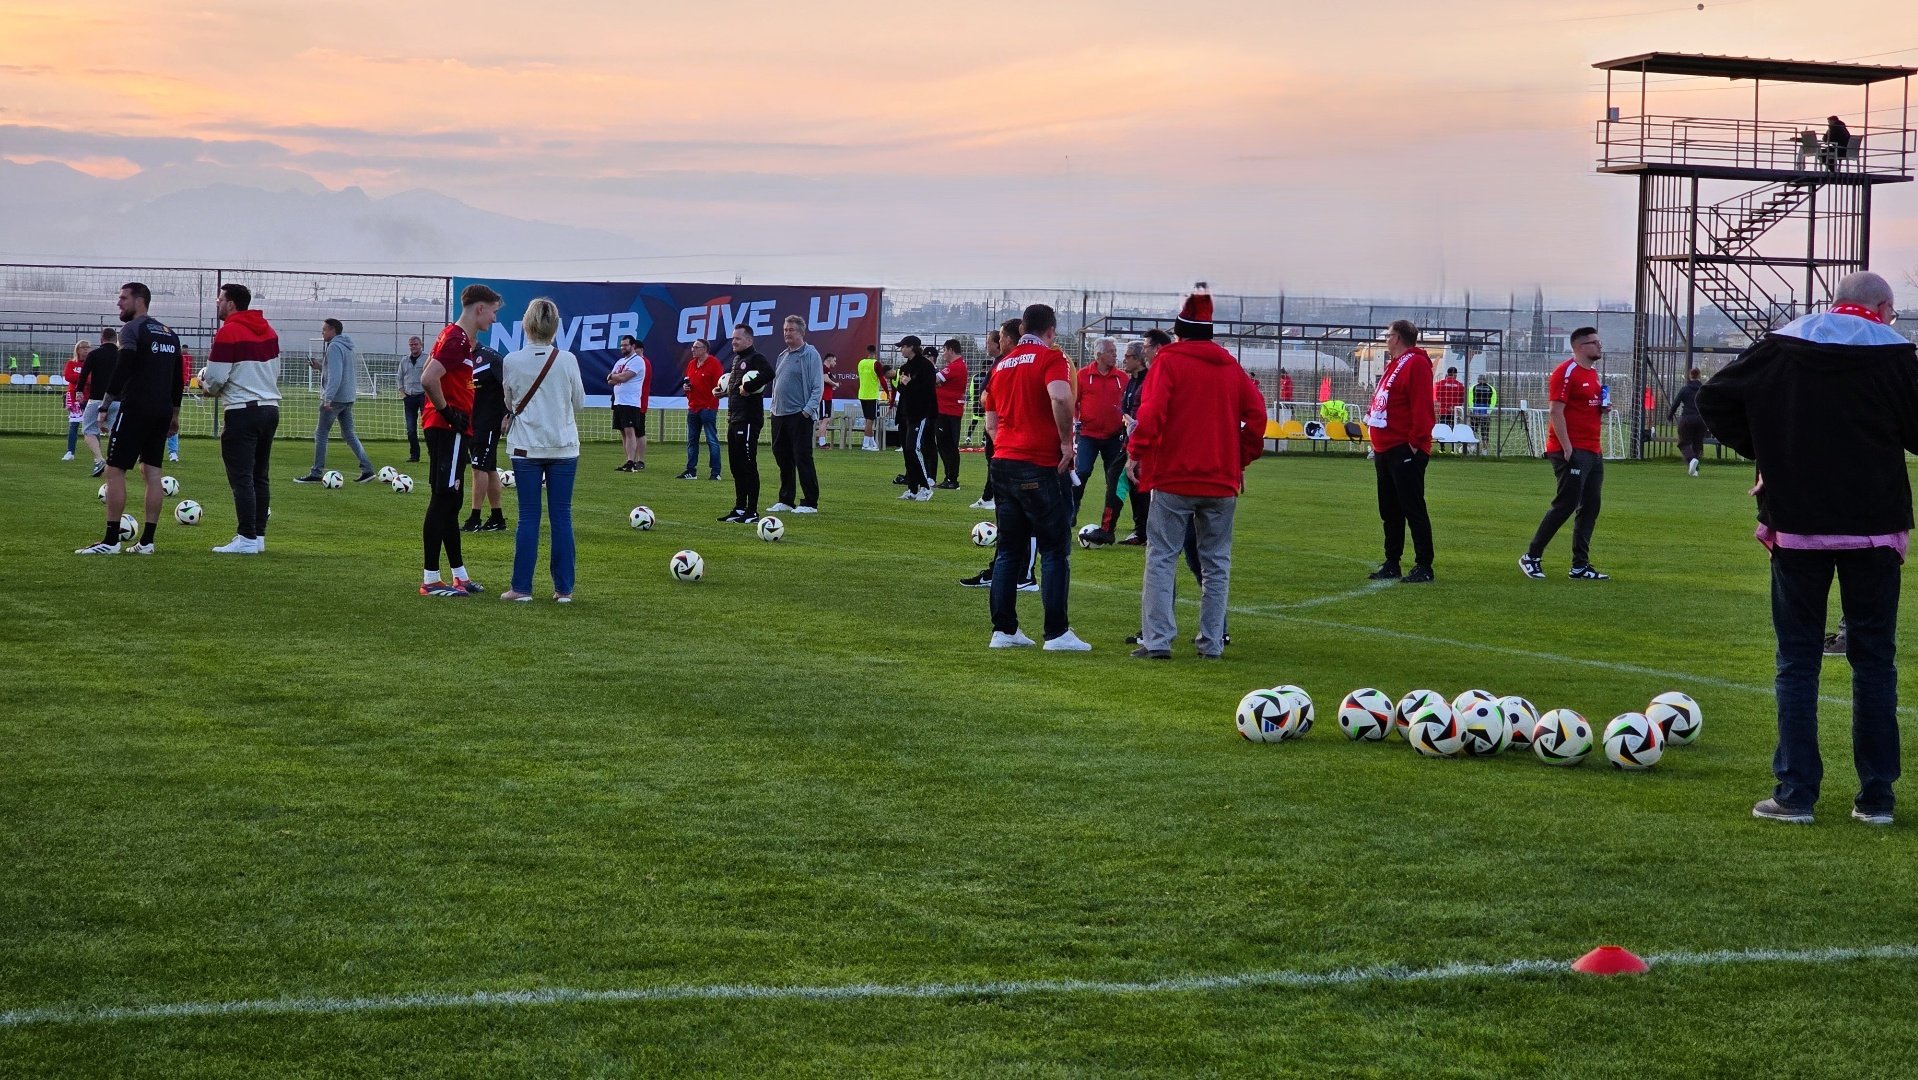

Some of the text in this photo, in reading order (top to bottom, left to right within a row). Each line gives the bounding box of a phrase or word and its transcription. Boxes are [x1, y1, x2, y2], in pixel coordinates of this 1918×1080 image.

[489, 293, 868, 354] NVER GIVE UP
[159, 344, 175, 353] JAKO
